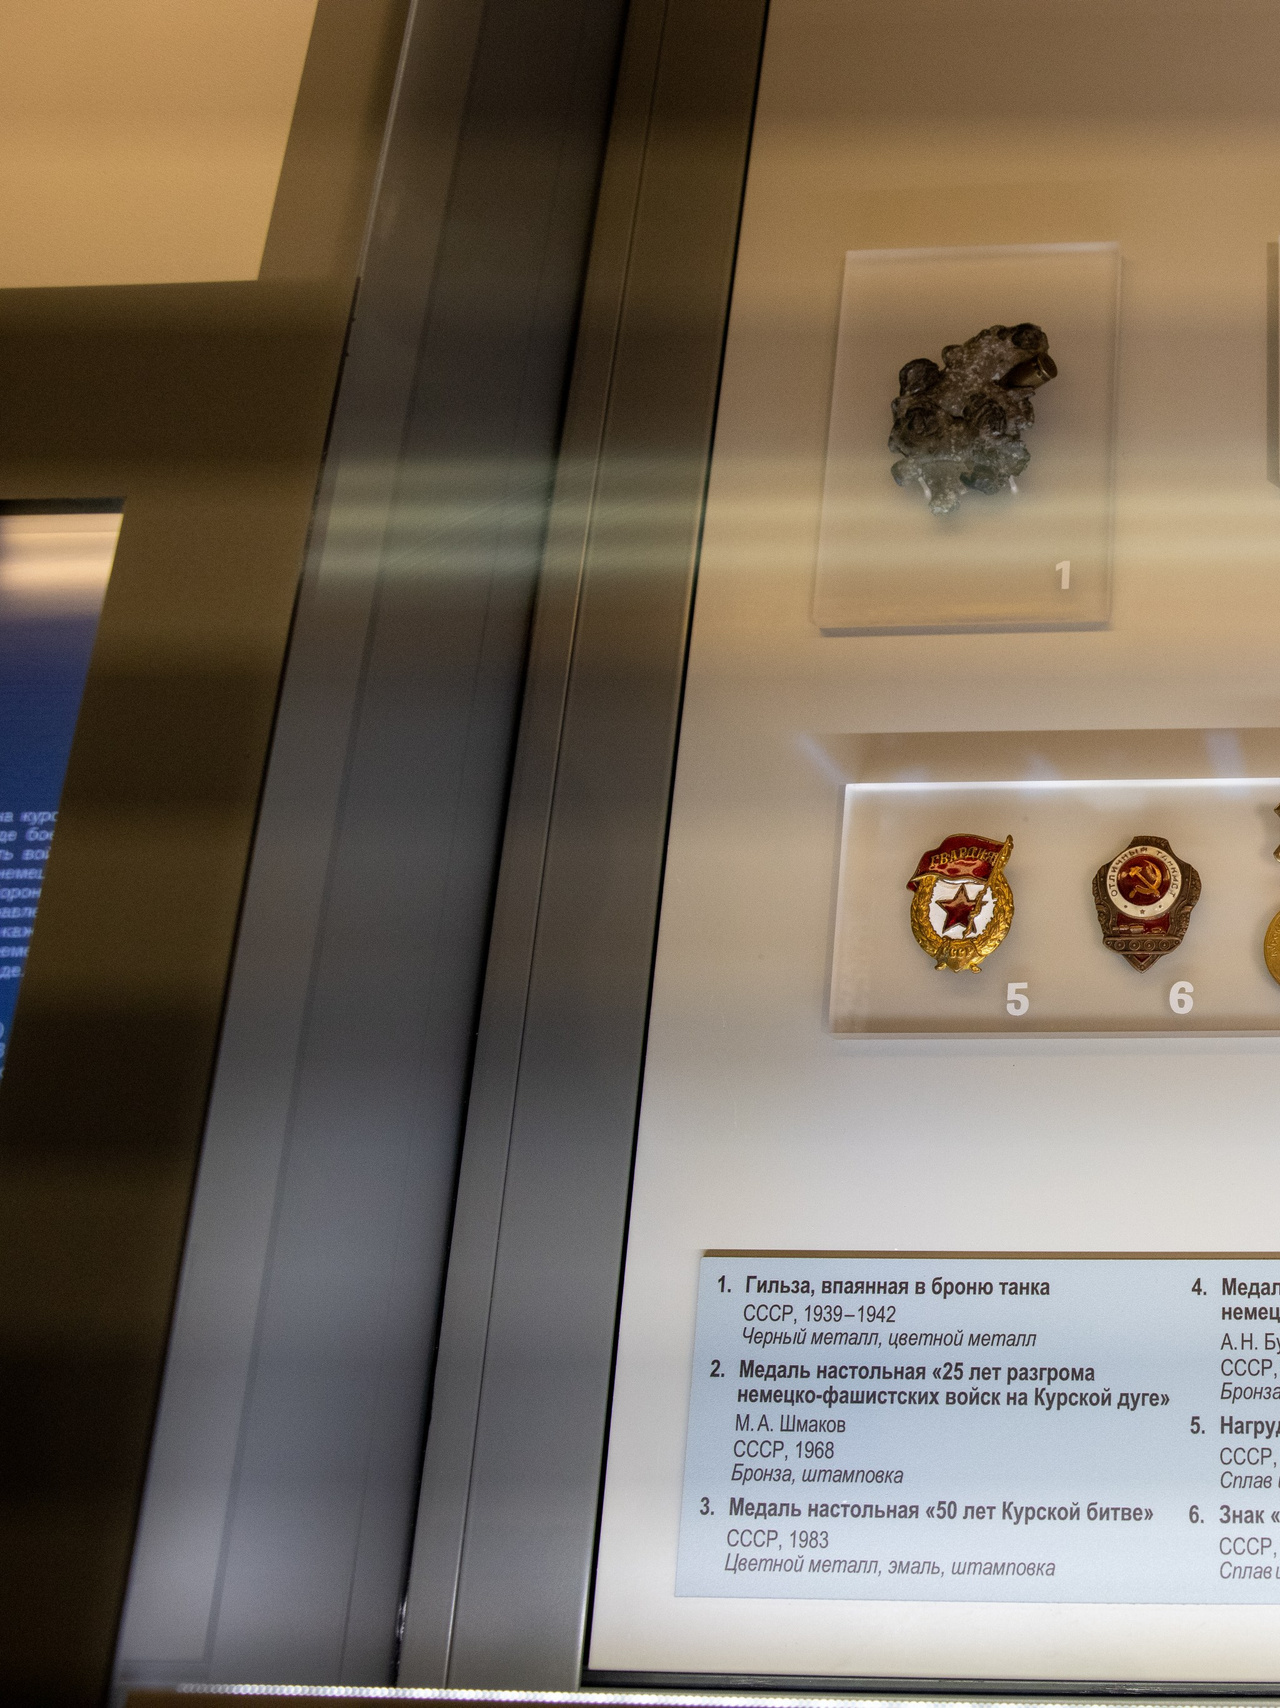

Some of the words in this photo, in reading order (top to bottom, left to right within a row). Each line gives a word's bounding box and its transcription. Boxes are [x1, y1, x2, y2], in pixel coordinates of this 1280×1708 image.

[1055, 560, 1070, 590] 1
[931, 847, 1000, 867] ГВАРДИЯ
[1006, 982, 1030, 1016] 5
[1169, 980, 1194, 1015] 6
[717, 1274, 732, 1293] 1.
[745, 1275, 815, 1298] Гильза,
[821, 1280, 909, 1295] впаянная
[914, 1281, 926, 1295] в
[931, 1276, 994, 1300] броню
[998, 1281, 1050, 1296] танка
[1191, 1277, 1207, 1296] 4.
[743, 1303, 797, 1325] СССР,
[742, 1326, 807, 1349] Черный
[810, 1331, 882, 1349] металл,
[888, 1329, 964, 1349] цветной
[967, 1333, 1037, 1347] металл
[709, 1359, 725, 1378] 2.
[739, 1359, 811, 1382] Медаль
[816, 1364, 926, 1381] настольная
[932, 1361, 964, 1381] «25
[968, 1366, 1002, 1381] лет
[1006, 1366, 1095, 1386] разгрома
[737, 1385, 940, 1409] немецко-фашистских
[945, 1387, 1001, 1406] войск
[1006, 1391, 1028, 1406] на
[1034, 1387, 1112, 1411] Курской
[1116, 1392, 1171, 1412] дуге»
[779, 1414, 846, 1433] Шмаков
[1190, 1415, 1206, 1435] 5.
[1220, 1470, 1273, 1489] Сплав
[699, 1496, 715, 1516] 3.
[728, 1496, 802, 1520] Медаль
[807, 1503, 920, 1519] настольная
[925, 1500, 958, 1520] «50
[962, 1505, 997, 1520] лет
[1001, 1500, 1081, 1526] Курской
[1086, 1501, 1154, 1522] битве»
[1188, 1504, 1205, 1524] 6.
[1219, 1504, 1265, 1524] Знак
[1219, 1536, 1277, 1559] СССР,
[724, 1552, 805, 1575] Цветной
[807, 1558, 882, 1577] металл,
[887, 1560, 945, 1578] эмаль,
[951, 1561, 1056, 1577] штамповка
[1219, 1560, 1273, 1580] Сплав
